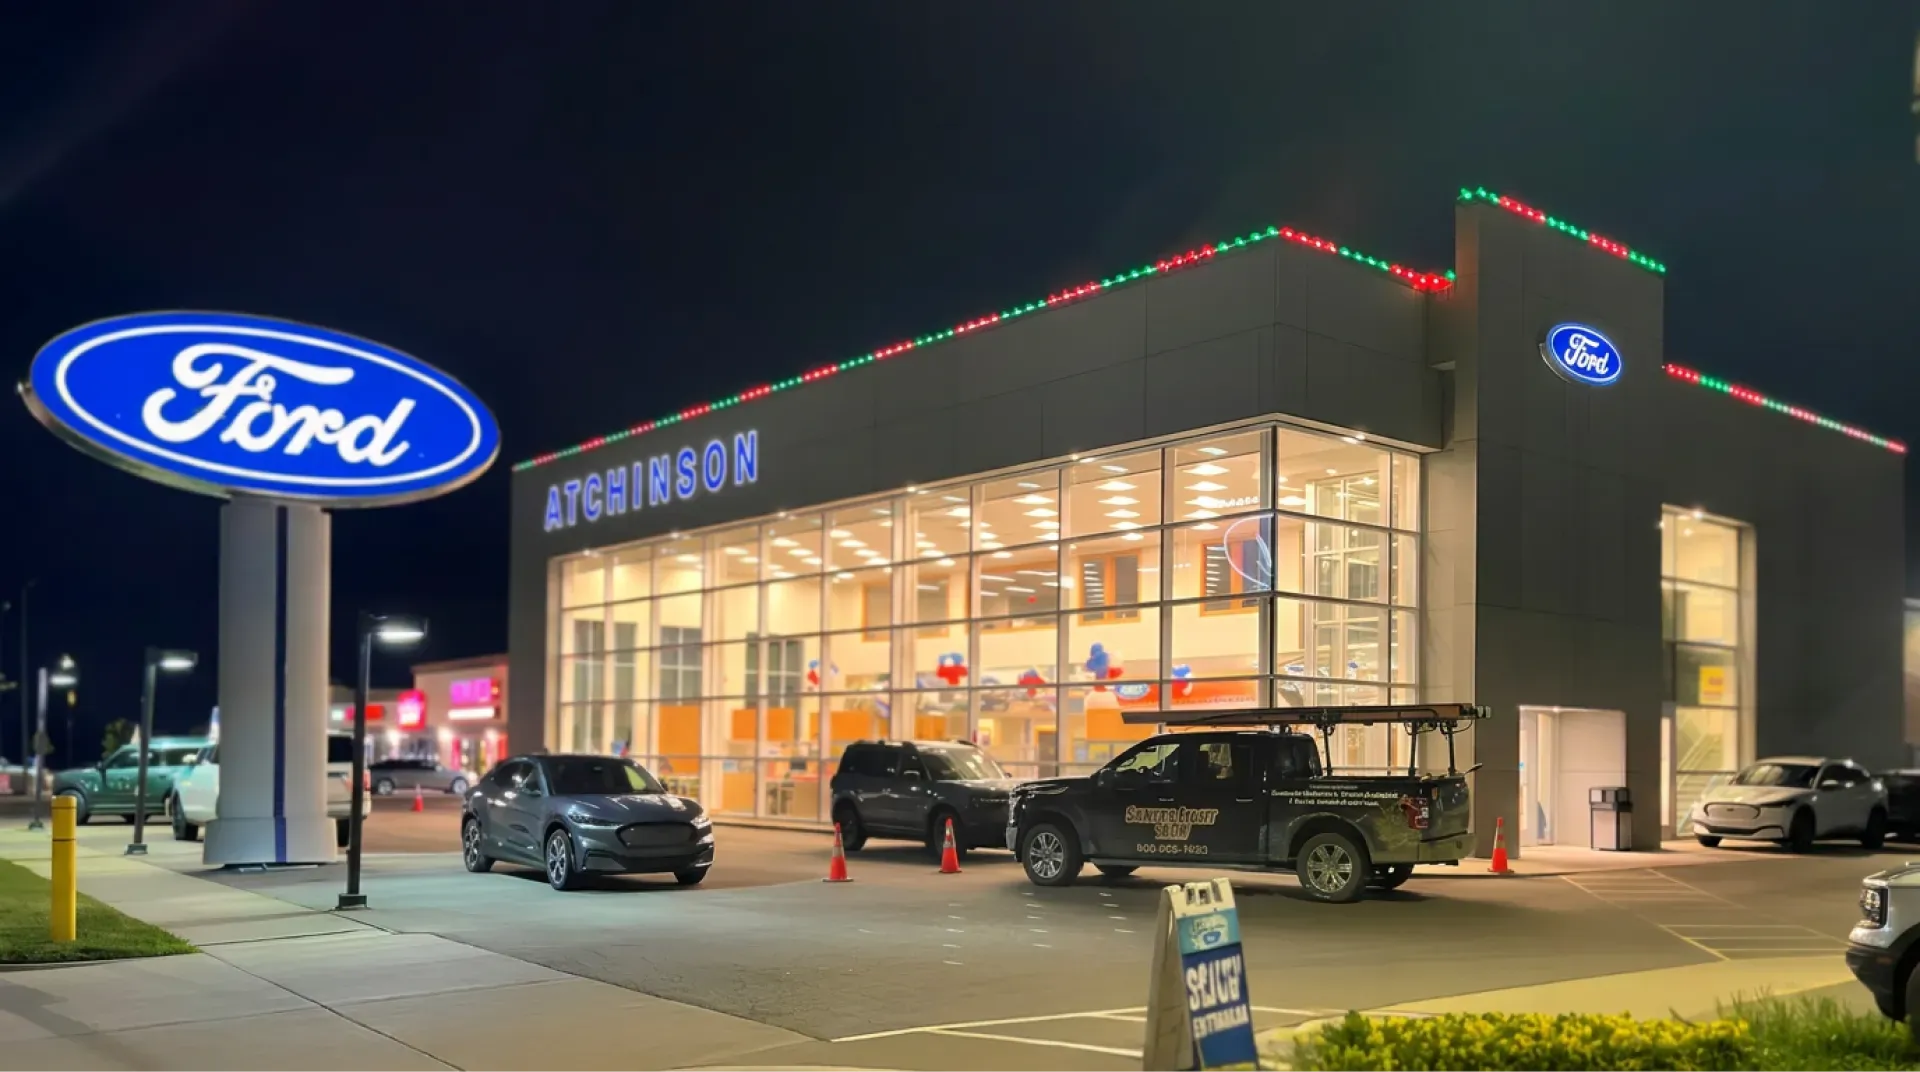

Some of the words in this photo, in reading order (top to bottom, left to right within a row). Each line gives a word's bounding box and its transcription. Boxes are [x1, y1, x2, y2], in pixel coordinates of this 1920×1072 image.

[142, 342, 416, 467] Ford
[1564, 333, 1609, 375] Ford
[543, 429, 758, 533] ATCHINSON
